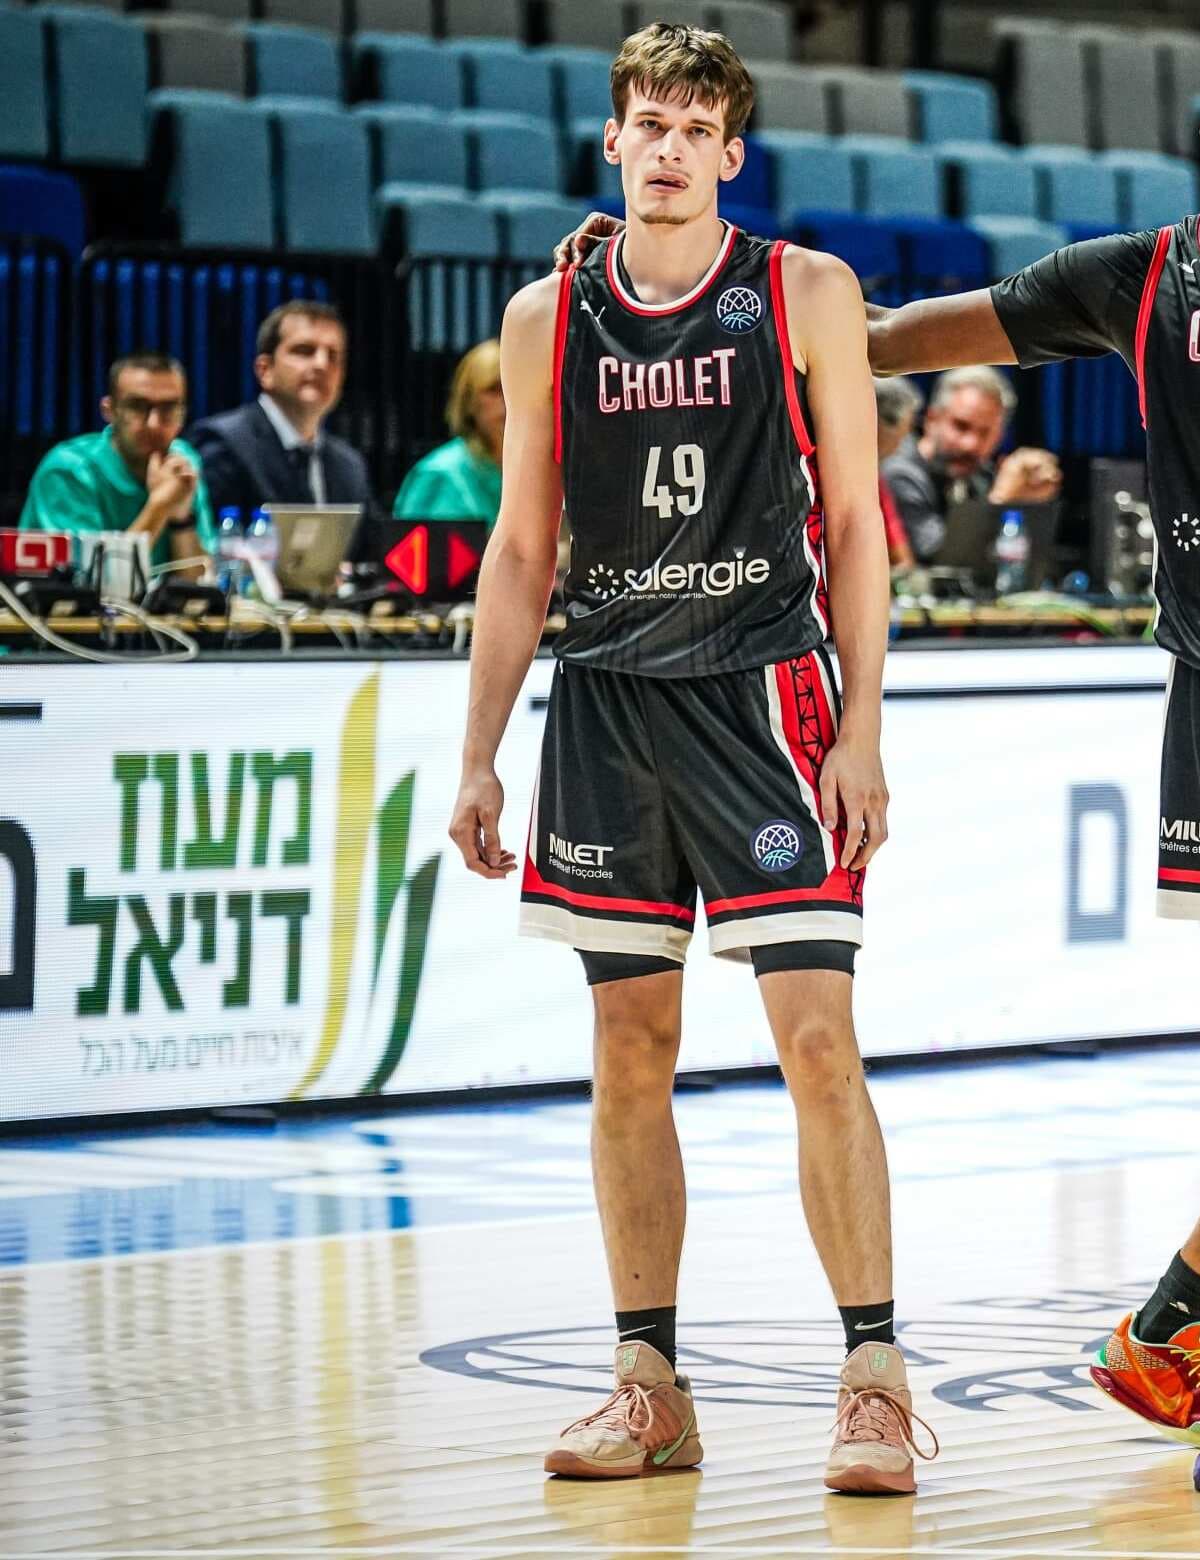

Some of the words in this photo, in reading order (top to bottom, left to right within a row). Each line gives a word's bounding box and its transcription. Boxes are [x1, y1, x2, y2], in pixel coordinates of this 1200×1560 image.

[598, 348, 736, 413] CHOLET
[642, 444, 705, 518] 49
[624, 551, 770, 596] solengie
[113, 748, 313, 872] מעוז
[549, 833, 614, 866] MILLET
[571, 865, 613, 880] Façades
[1192, 845, 1200, 854] et
[67, 866, 311, 1017] דניאל
